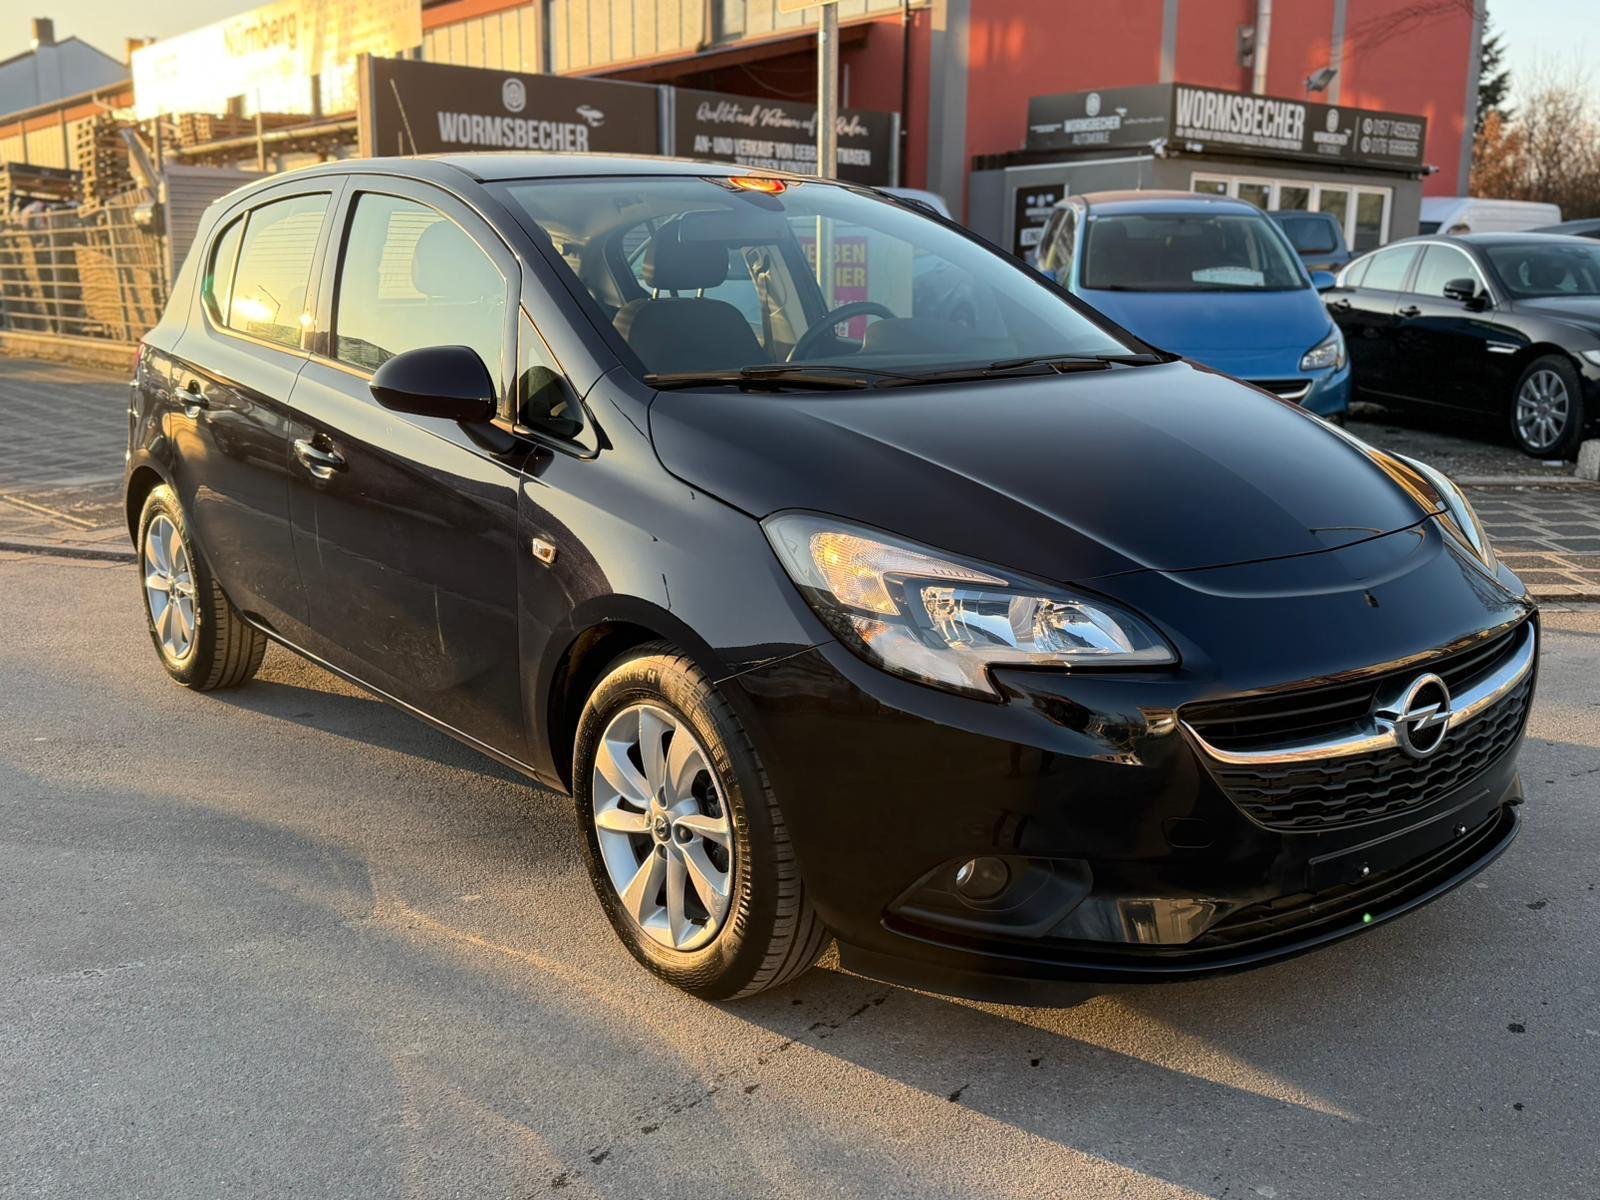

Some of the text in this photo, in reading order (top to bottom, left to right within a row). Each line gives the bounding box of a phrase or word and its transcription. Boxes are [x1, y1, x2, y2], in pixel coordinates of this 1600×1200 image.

[1175, 87, 1306, 141] WORMSBECHER
[437, 111, 590, 152] WORMSBECHER
[734, 139, 775, 159] VERKAUF
[832, 267, 866, 288] IER
